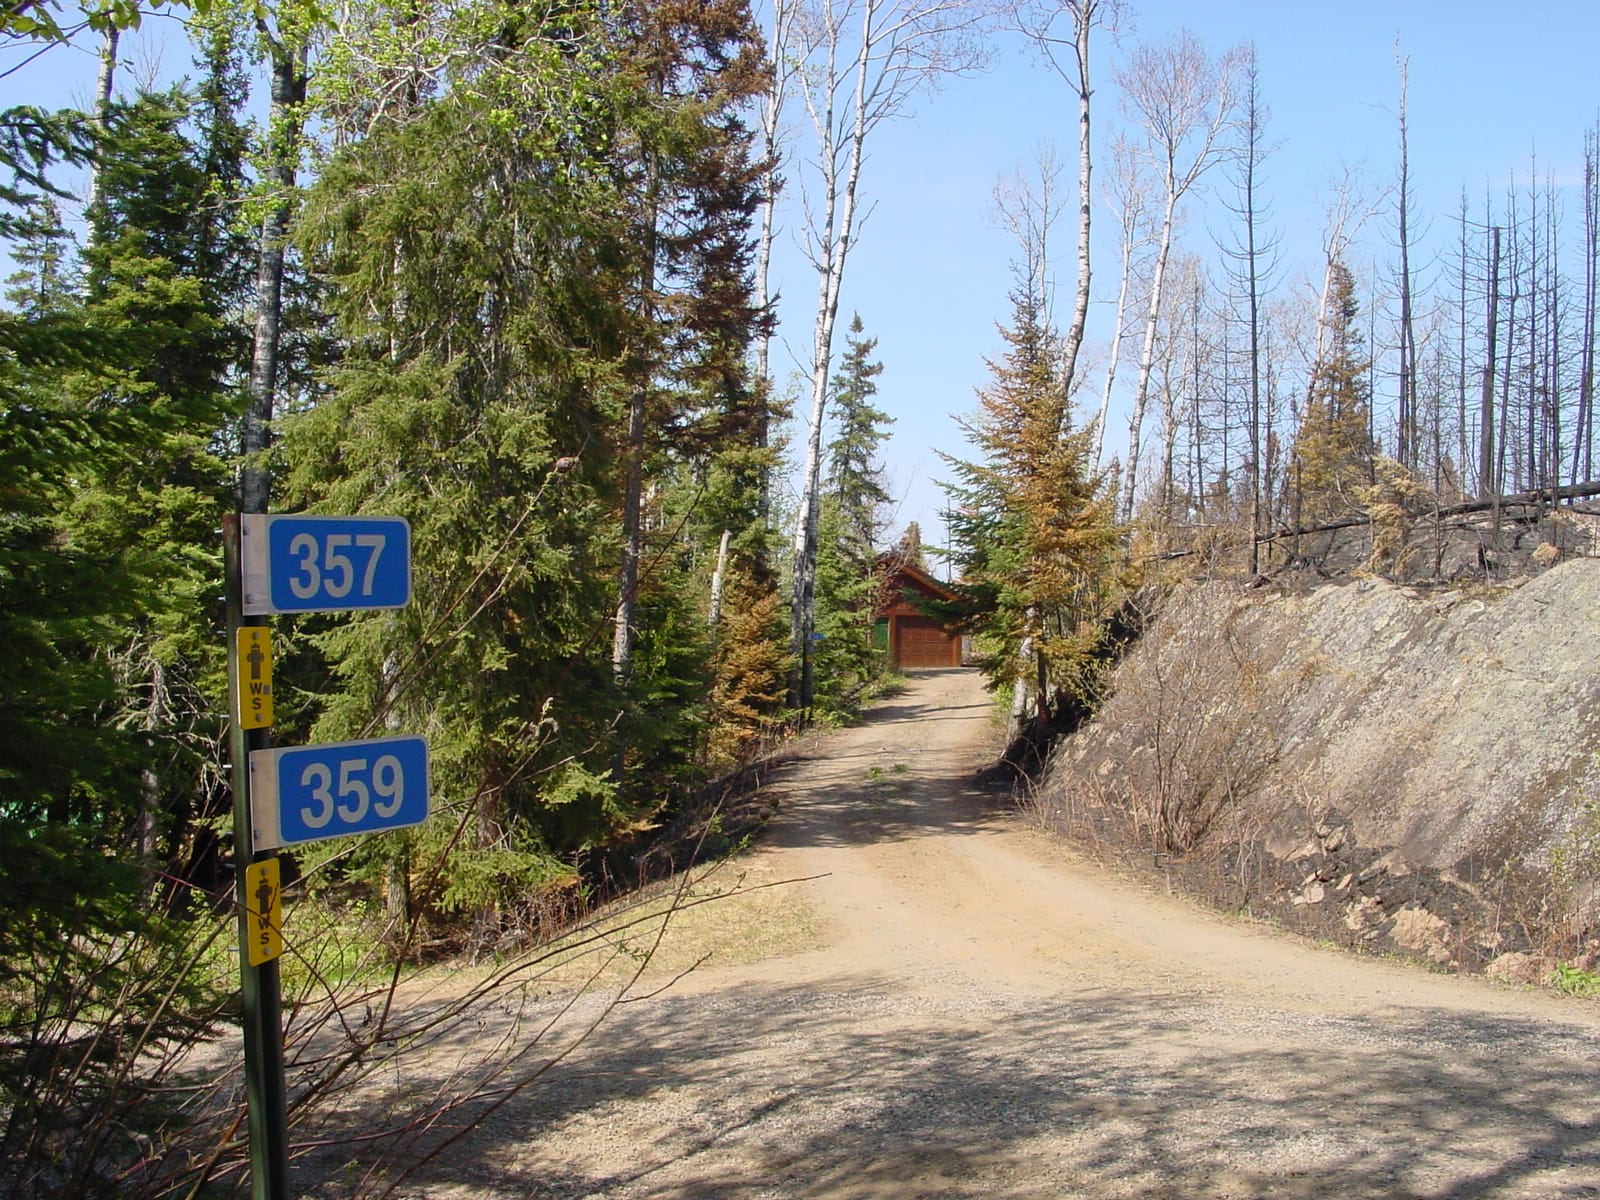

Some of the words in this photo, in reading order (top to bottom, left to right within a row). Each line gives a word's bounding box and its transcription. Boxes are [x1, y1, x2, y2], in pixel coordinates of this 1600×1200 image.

[289, 533, 386, 599] 357
[249, 682, 263, 695] W
[252, 697, 262, 710] S
[301, 755, 404, 829] 359
[260, 932, 270, 945] S
